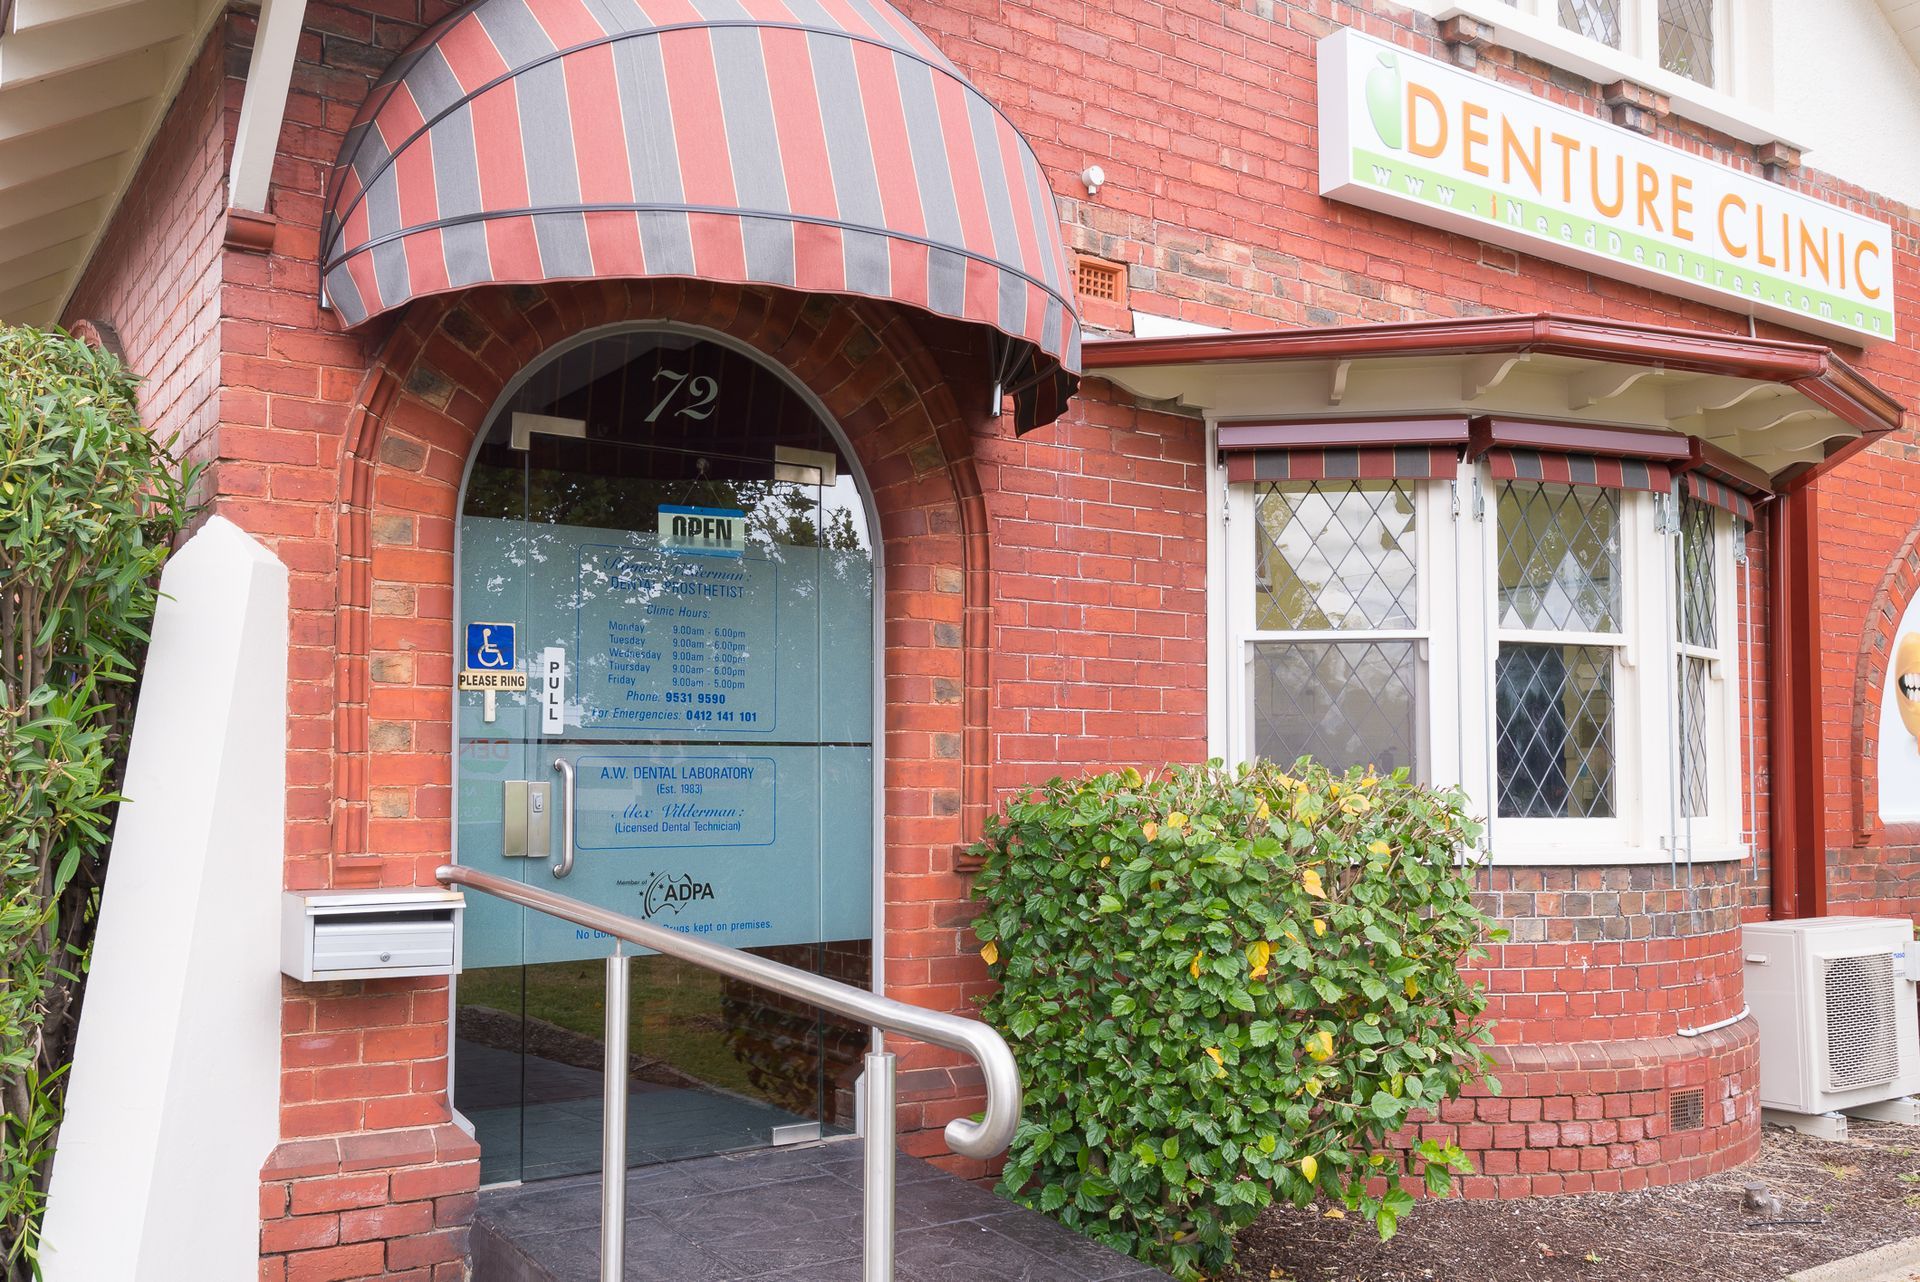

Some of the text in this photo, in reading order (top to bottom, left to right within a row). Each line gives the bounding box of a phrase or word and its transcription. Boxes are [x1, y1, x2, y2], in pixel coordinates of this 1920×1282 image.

[1407, 80, 1881, 300] DENTURE CLINIC
[643, 366, 719, 423] 72
[672, 515, 733, 548] OPEN
[664, 580, 744, 599] PROSTHETIST
[646, 604, 711, 619] Clinic Hours:
[608, 620, 645, 632] Monday
[672, 625, 704, 636] 9.00am
[714, 628, 746, 639] 6.00pm
[609, 634, 646, 646] Tuesday
[672, 639, 704, 649] 9.00am
[714, 641, 746, 652] 6.00pm
[609, 648, 662, 661] Wednesday
[672, 652, 704, 662] 9.00am
[714, 654, 746, 665] 6.00pm
[608, 661, 651, 674] Thursday
[672, 664, 704, 675] 9.00am
[714, 667, 745, 677] 6.00pm
[459, 674, 525, 687] PLEASE RING
[608, 674, 636, 686] Friday
[672, 677, 704, 688] 9.00am
[714, 679, 745, 690] 5.00pm
[549, 661, 560, 720] PULL
[665, 692, 693, 703] 9531
[697, 693, 726, 705] 9590
[613, 707, 682, 721] Emergencies:
[686, 709, 712, 721] 0412
[717, 710, 734, 721] 141
[740, 711, 757, 722] 101
[600, 766, 755, 780] A.W. DENTAL LABORATORY
[656, 783, 703, 796] (Est. 1983)
[615, 820, 741, 835] (Licensed Dental Technician)
[616, 879, 640, 887] Member
[664, 883, 715, 902] ADPA
[576, 928, 590, 940] No
[693, 922, 714, 933] kept
[716, 922, 727, 932] on
[731, 919, 773, 931] premises.
